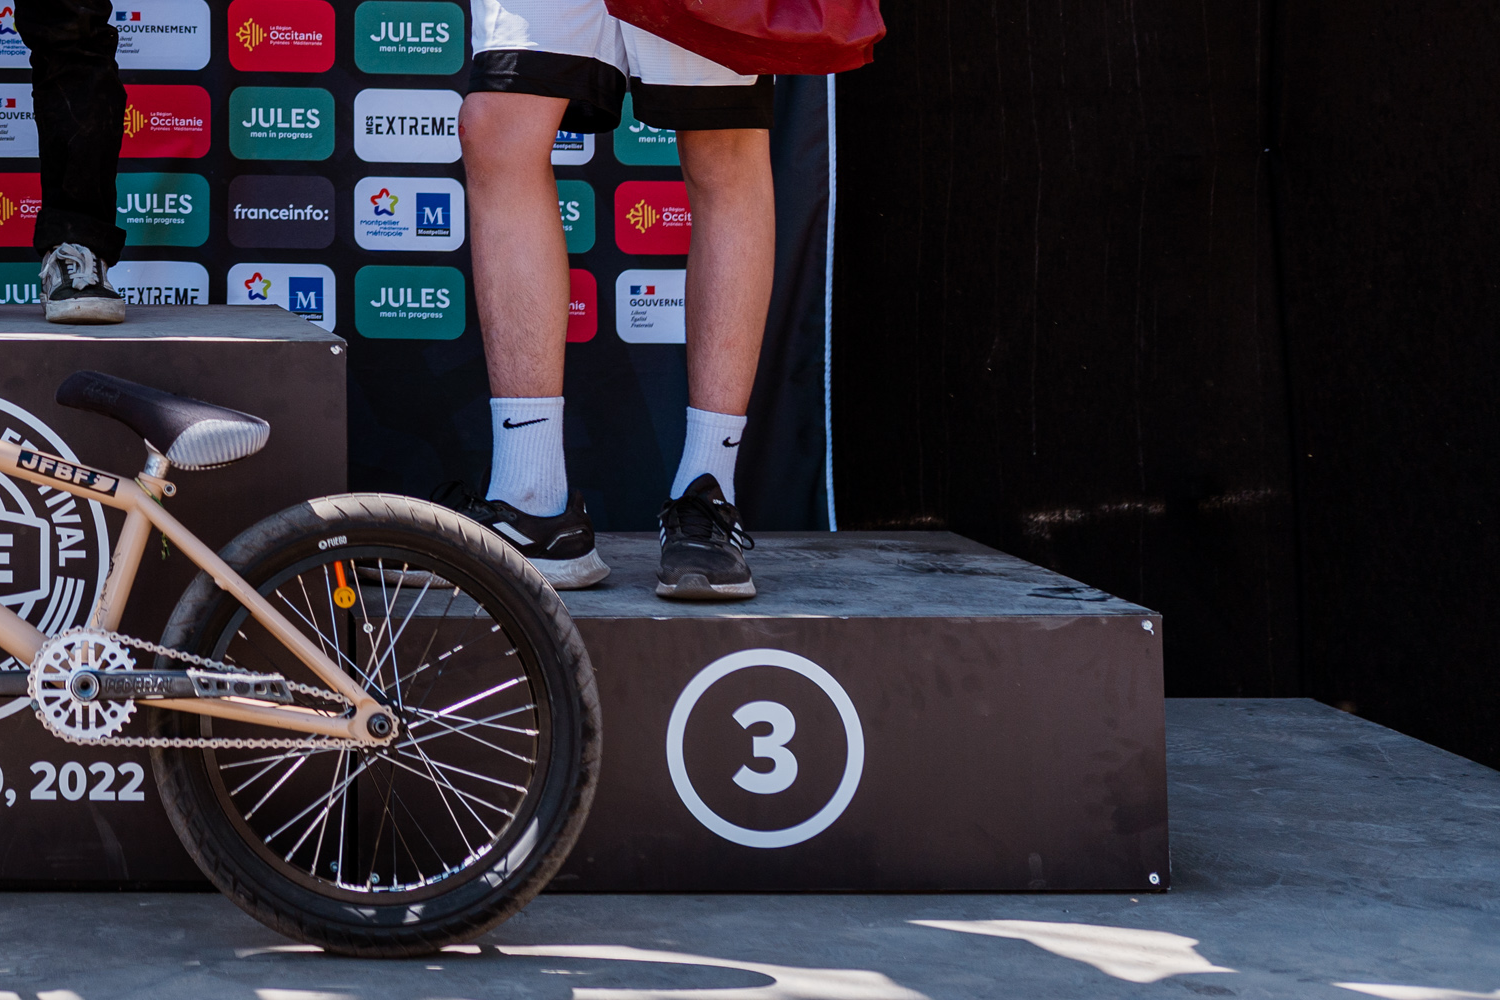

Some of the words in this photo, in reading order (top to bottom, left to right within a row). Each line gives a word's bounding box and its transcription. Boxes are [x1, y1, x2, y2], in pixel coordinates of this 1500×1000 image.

[270, 31, 322, 41] Occitanie
[370, 22, 450, 43] JULES
[399, 44, 406, 52] in
[408, 45, 442, 54] progress
[150, 116, 203, 126] Occitanie
[242, 108, 320, 129] JULES
[376, 116, 456, 136] EXTREME
[269, 130, 277, 138] in
[279, 131, 312, 139] progress
[117, 194, 192, 214] JULES
[234, 204, 329, 220] franceinfo:
[154, 217, 185, 225] progress
[370, 288, 450, 308] JULES
[399, 310, 406, 318] in
[408, 311, 442, 319] progress
[732, 700, 798, 794] 3
[30, 762, 145, 801] 2022
